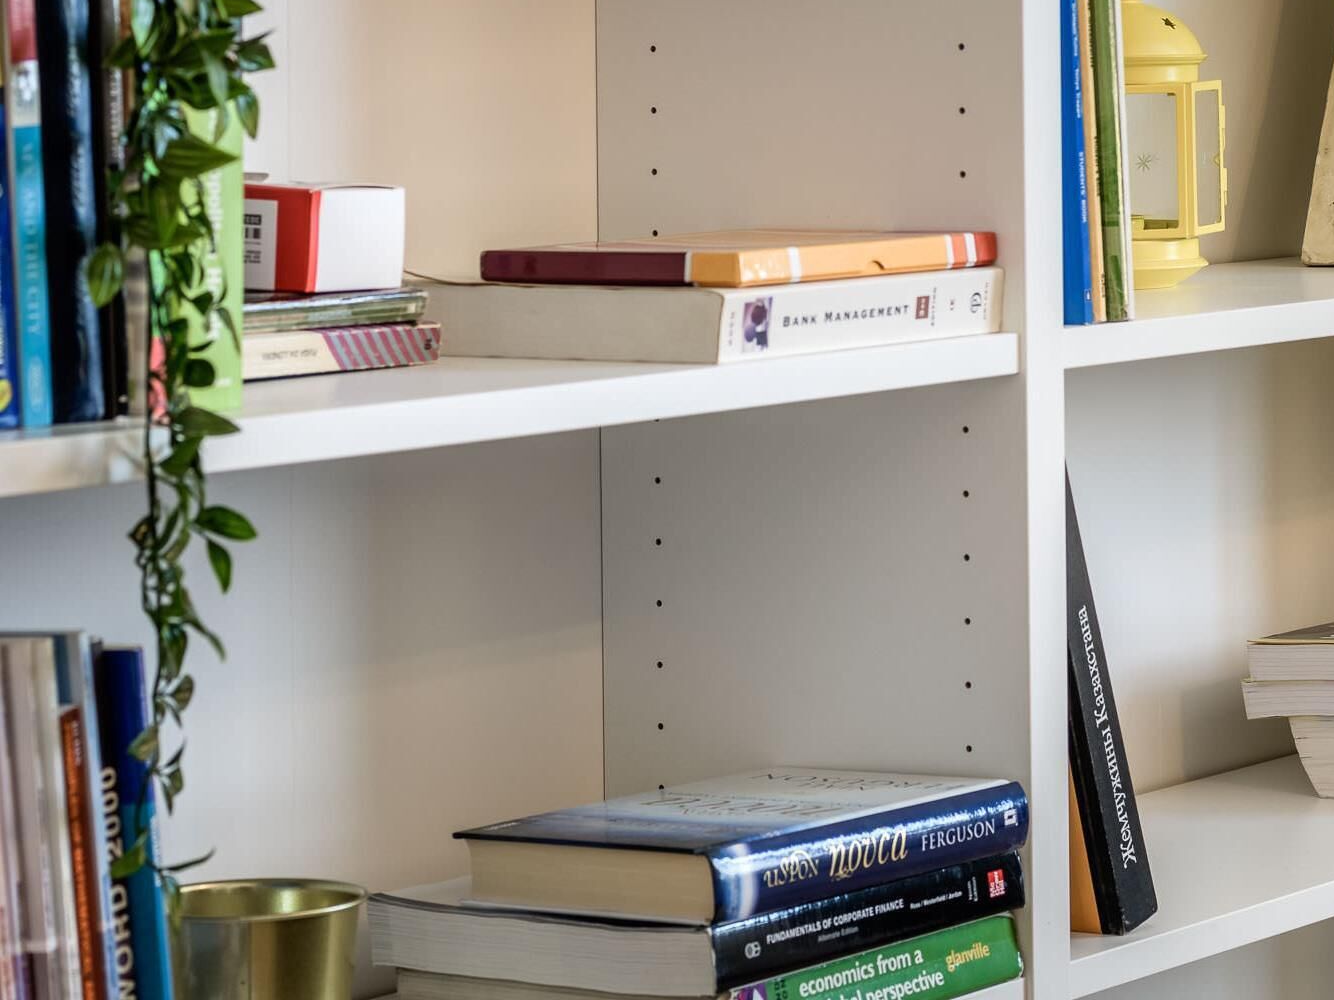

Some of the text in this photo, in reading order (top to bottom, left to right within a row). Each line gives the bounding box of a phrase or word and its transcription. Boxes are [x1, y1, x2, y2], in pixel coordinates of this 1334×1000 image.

[1081, 199, 1089, 224] BOOK
[27, 287, 41, 337] CITY
[783, 303, 910, 328] BANK MANAGEMENT
[1078, 604, 1137, 870] Жемчужины Казахстана
[100, 766, 124, 868] 2000
[921, 819, 997, 852] FERGUSON
[766, 898, 905, 945] FUNDAMENTALS OF CORPORATE FINANCE
[841, 926, 859, 938] Edition
[798, 961, 875, 998] economics
[877, 951, 913, 978] from
[914, 948, 924, 967] a
[945, 941, 991, 973] glanville
